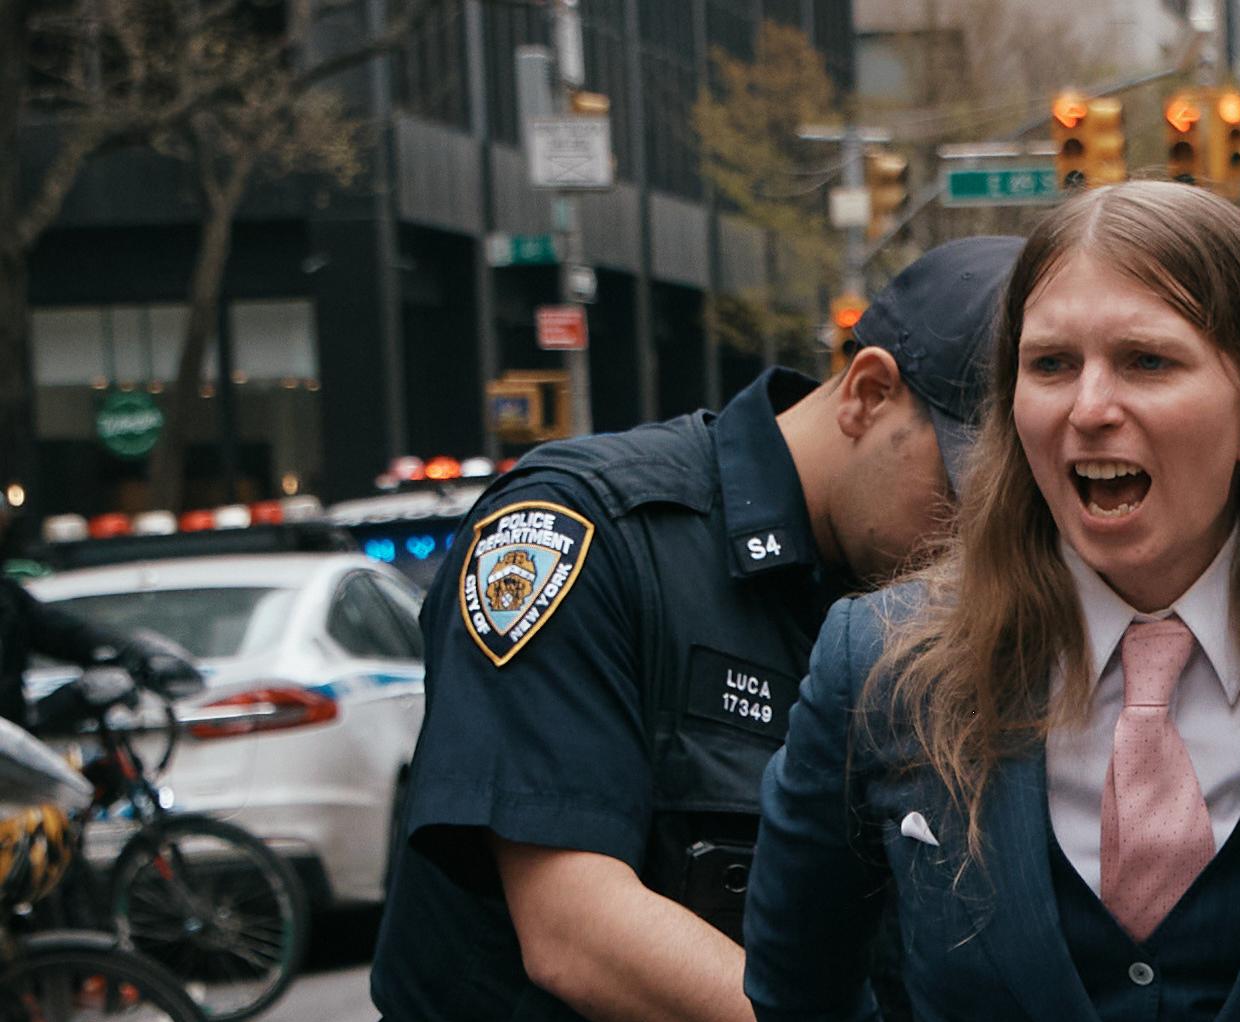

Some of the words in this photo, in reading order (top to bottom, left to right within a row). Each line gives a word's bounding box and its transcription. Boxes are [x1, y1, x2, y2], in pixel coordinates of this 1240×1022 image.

[497, 511, 557, 533] POLICE
[475, 527, 574, 557] DEPARTMENT
[747, 533, 782, 560] S4
[465, 574, 481, 612] CITY
[508, 607, 541, 643] NEW
[535, 563, 573, 606] YORK
[472, 612, 491, 635] OF
[726, 669, 771, 699] LUCA
[722, 693, 773, 723] 17349
